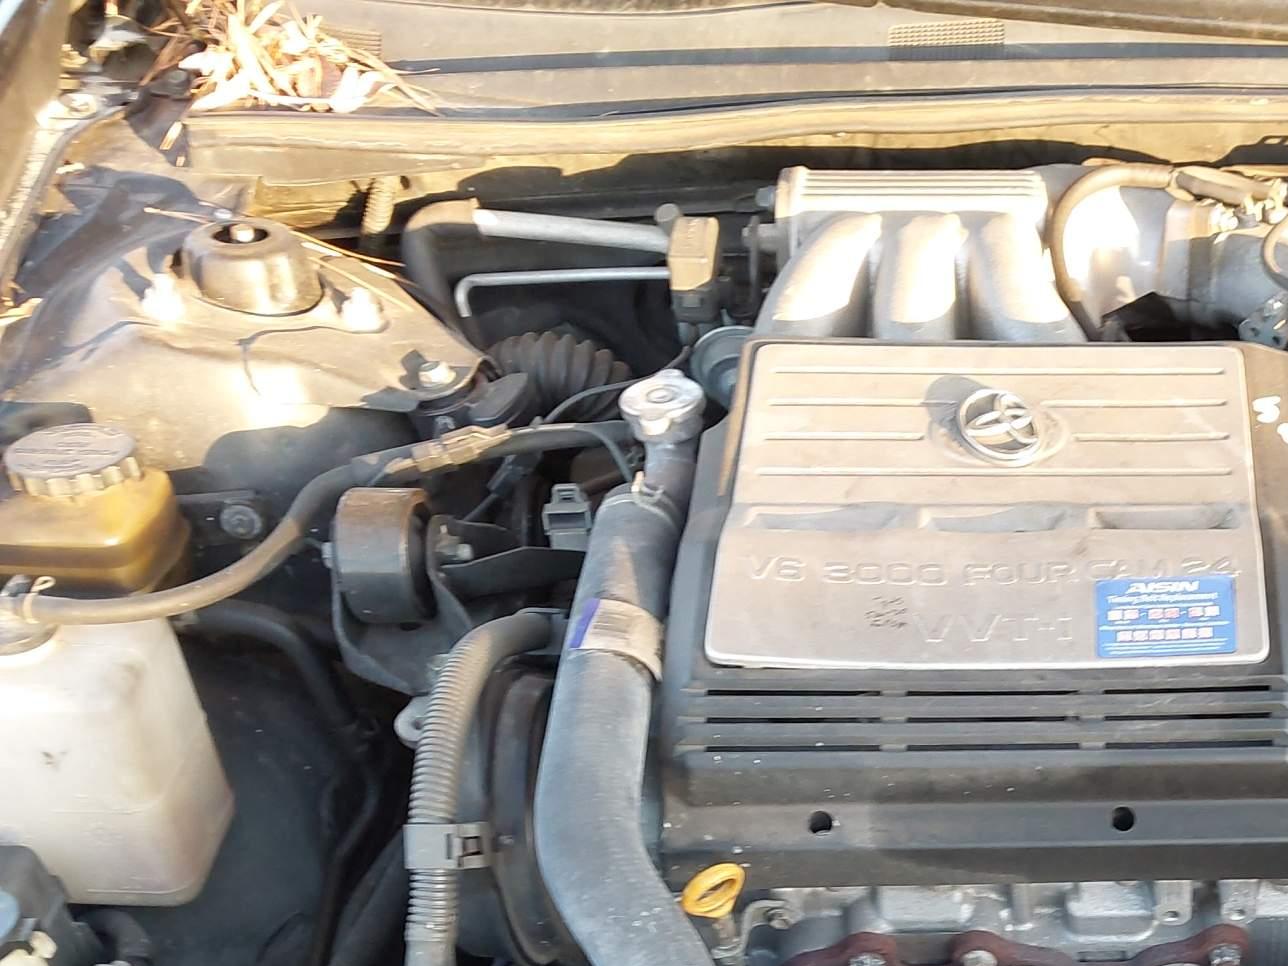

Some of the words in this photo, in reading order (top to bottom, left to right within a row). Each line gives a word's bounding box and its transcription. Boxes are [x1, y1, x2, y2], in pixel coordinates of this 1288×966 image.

[748, 556, 807, 582] V6
[822, 561, 949, 586] 3000
[962, 559, 1081, 586] FOUR
[1125, 581, 1200, 594] AISIN
